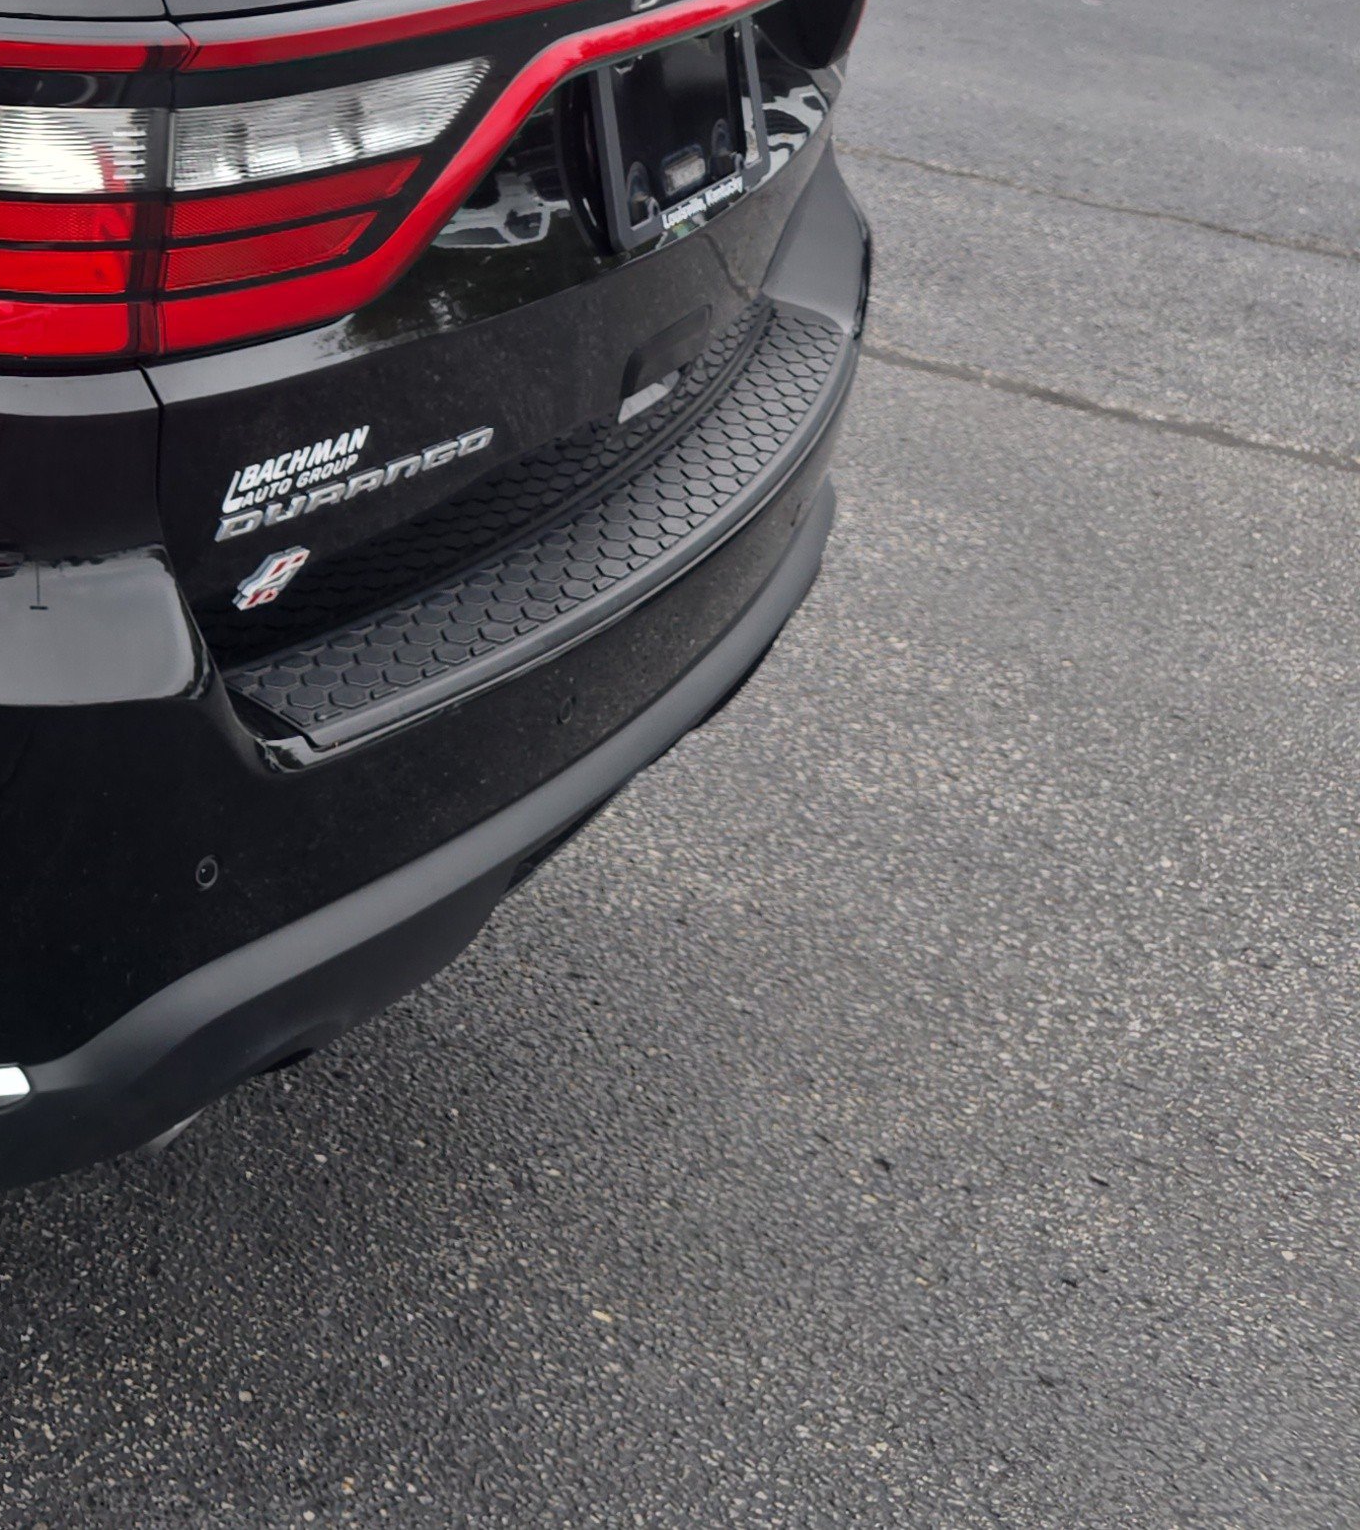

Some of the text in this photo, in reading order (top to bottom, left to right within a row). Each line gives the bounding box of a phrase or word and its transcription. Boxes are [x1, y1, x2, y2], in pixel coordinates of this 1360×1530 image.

[214, 426, 495, 542] DURANGO
[238, 424, 371, 492] BACHMAN
[239, 453, 359, 509] AUTO GROUP
